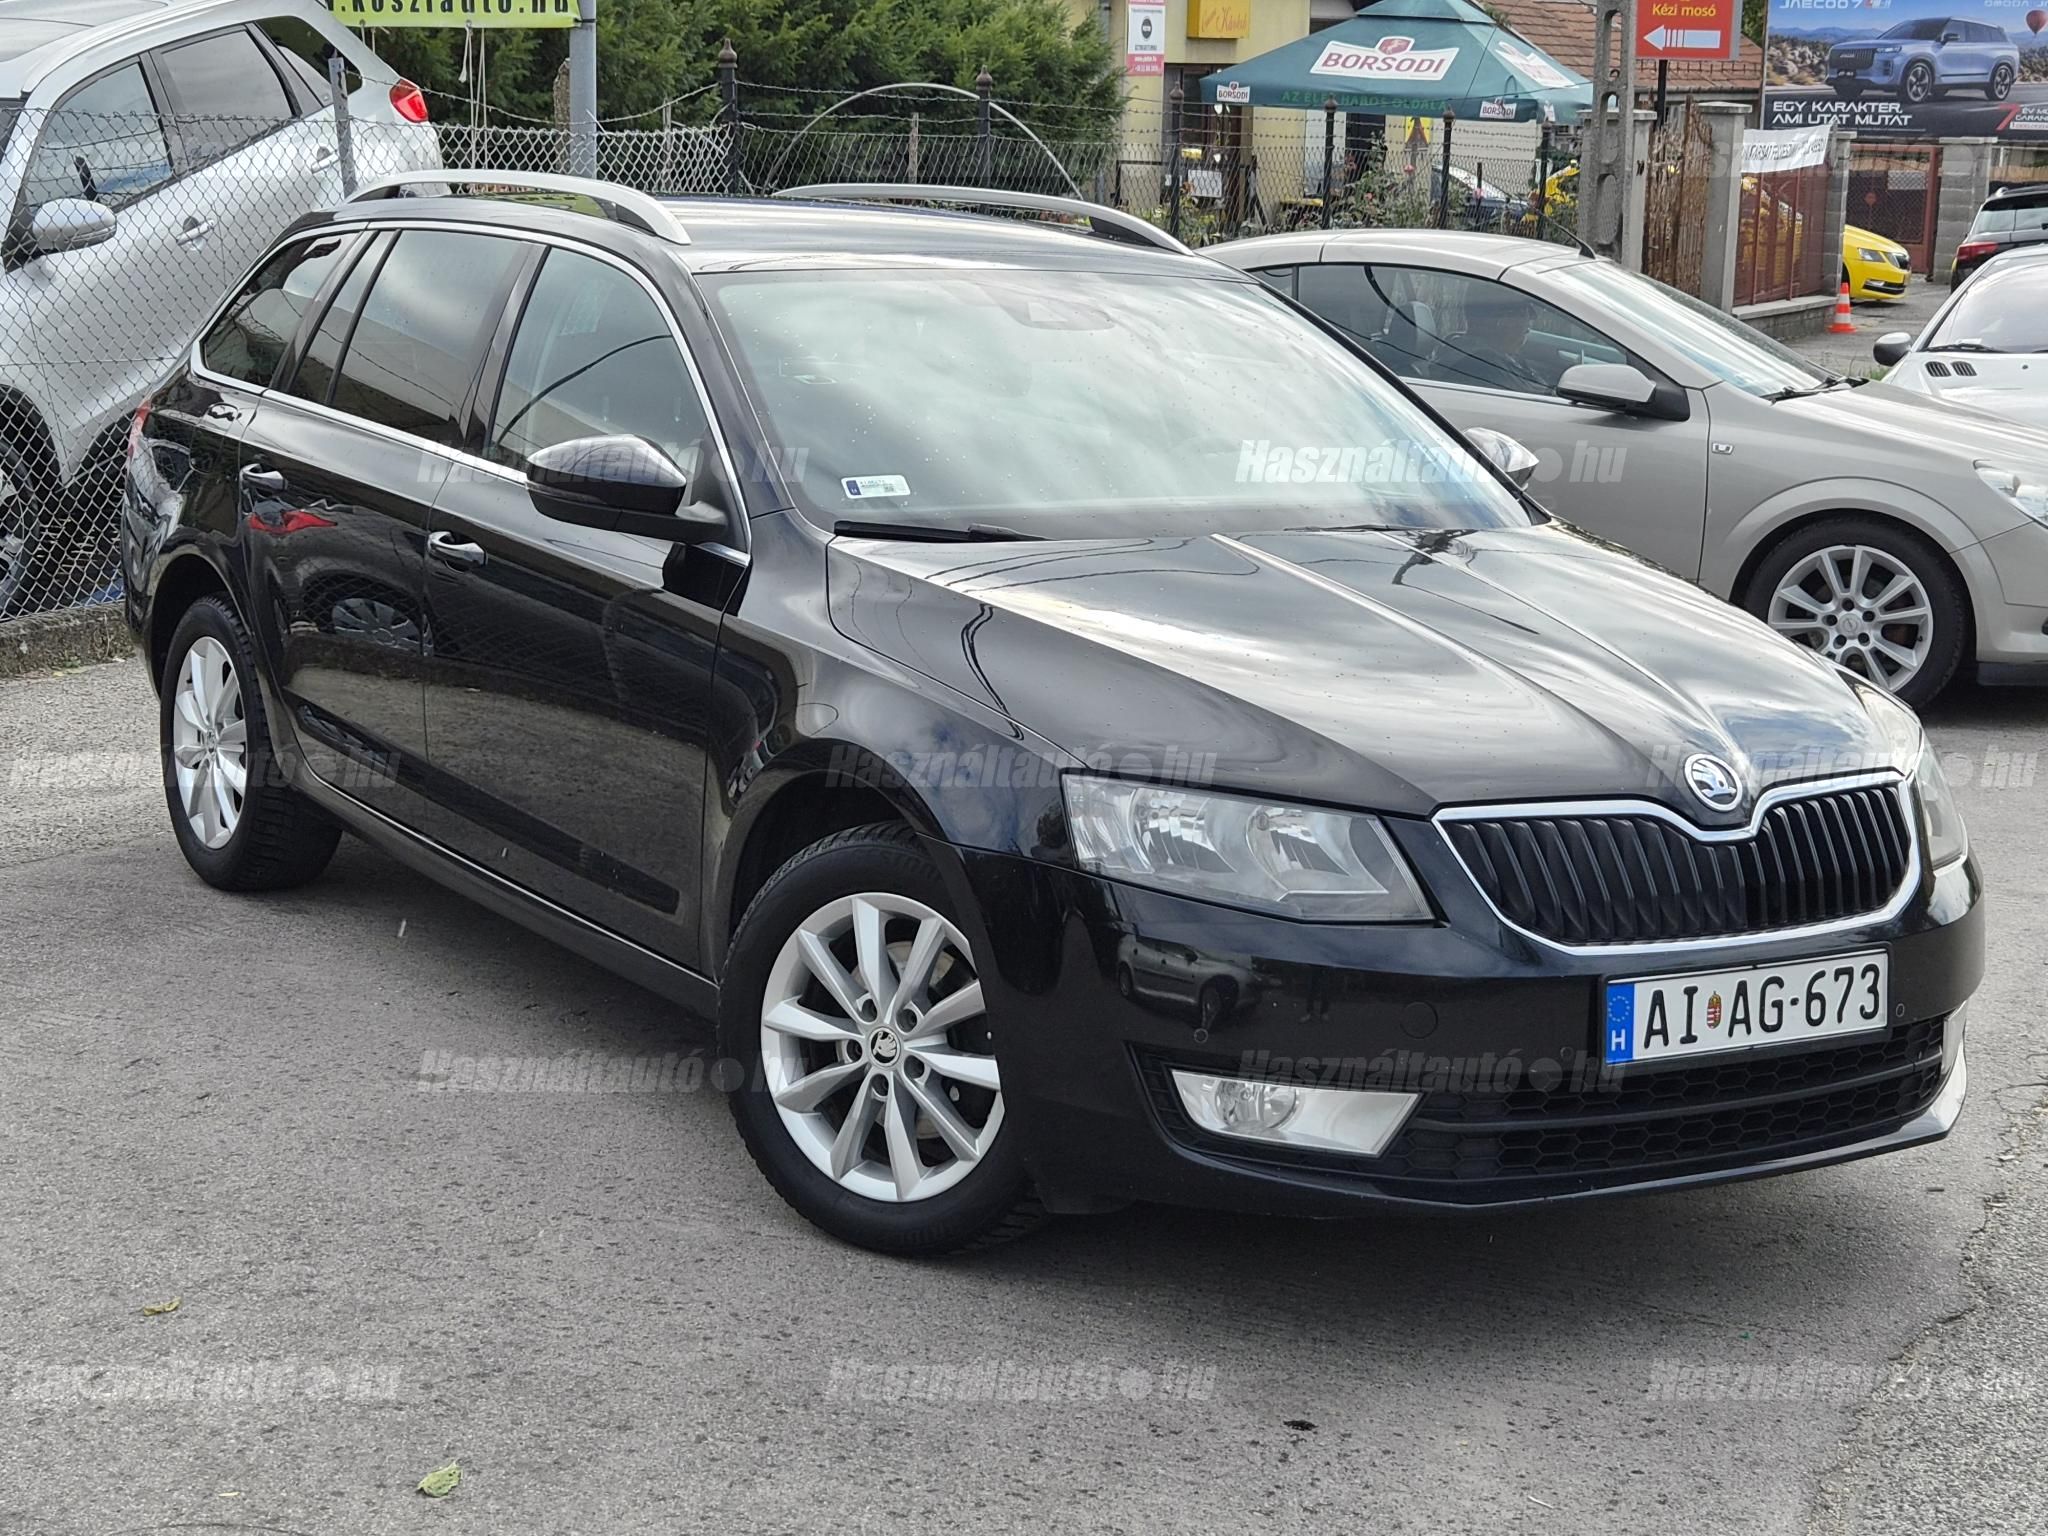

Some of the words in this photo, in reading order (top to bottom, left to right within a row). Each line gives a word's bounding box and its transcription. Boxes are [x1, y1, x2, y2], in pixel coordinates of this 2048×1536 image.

[1652, 3, 1678, 16] Kézi
[1681, 4, 1717, 17] mosó
[1321, 52, 1445, 73] BORSODI
[1218, 90, 1248, 99] BORSODI
[1773, 101, 1807, 112] EGY
[1812, 102, 1903, 113] KARAKTER,
[1772, 114, 1803, 124] AMI
[1808, 114, 1850, 125] UTAT
[1855, 115, 1912, 126] MUTAT
[1644, 985, 1699, 1049] AI
[1728, 963, 1880, 1038] AG-673
[1611, 1029, 1626, 1051] H
